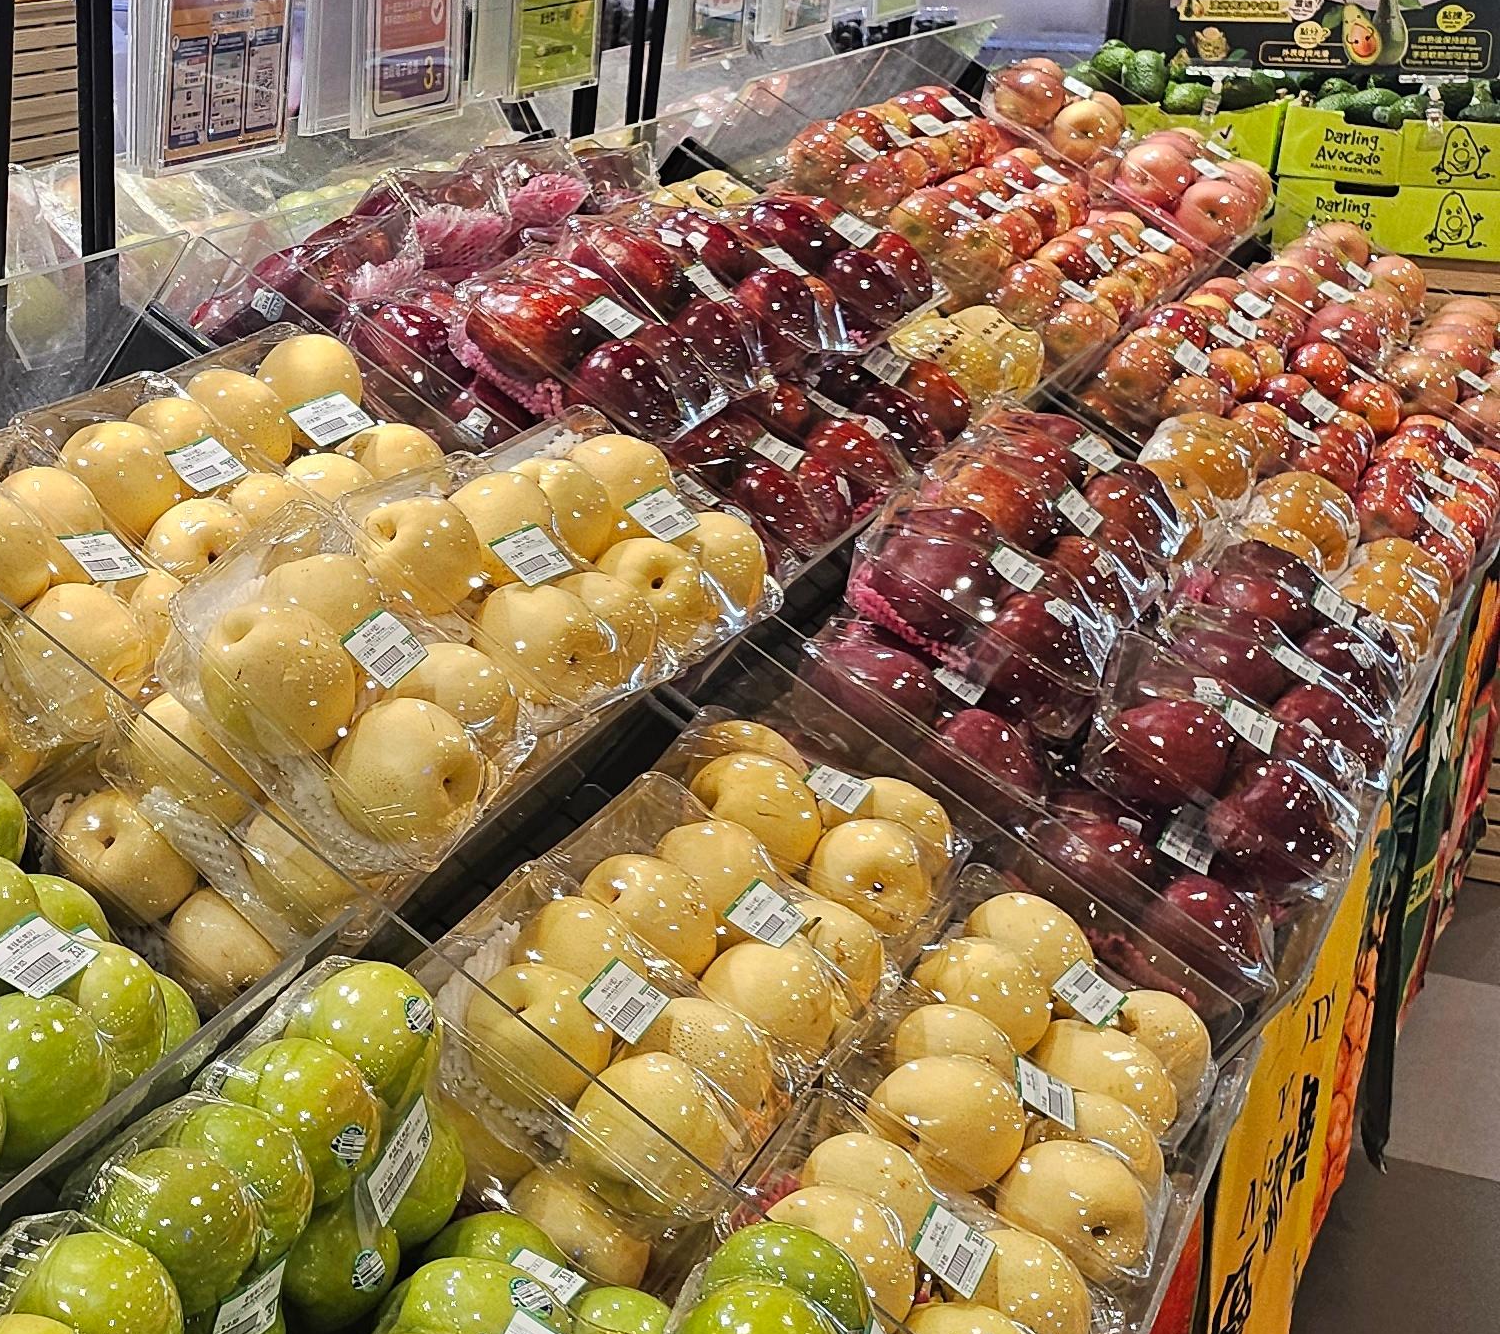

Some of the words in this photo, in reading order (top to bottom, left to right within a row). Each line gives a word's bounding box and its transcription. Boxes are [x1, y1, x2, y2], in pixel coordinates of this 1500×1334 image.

[1324, 128, 1380, 152] Darling
[1315, 146, 1381, 167] Avocado
[1316, 196, 1371, 218] Darling
